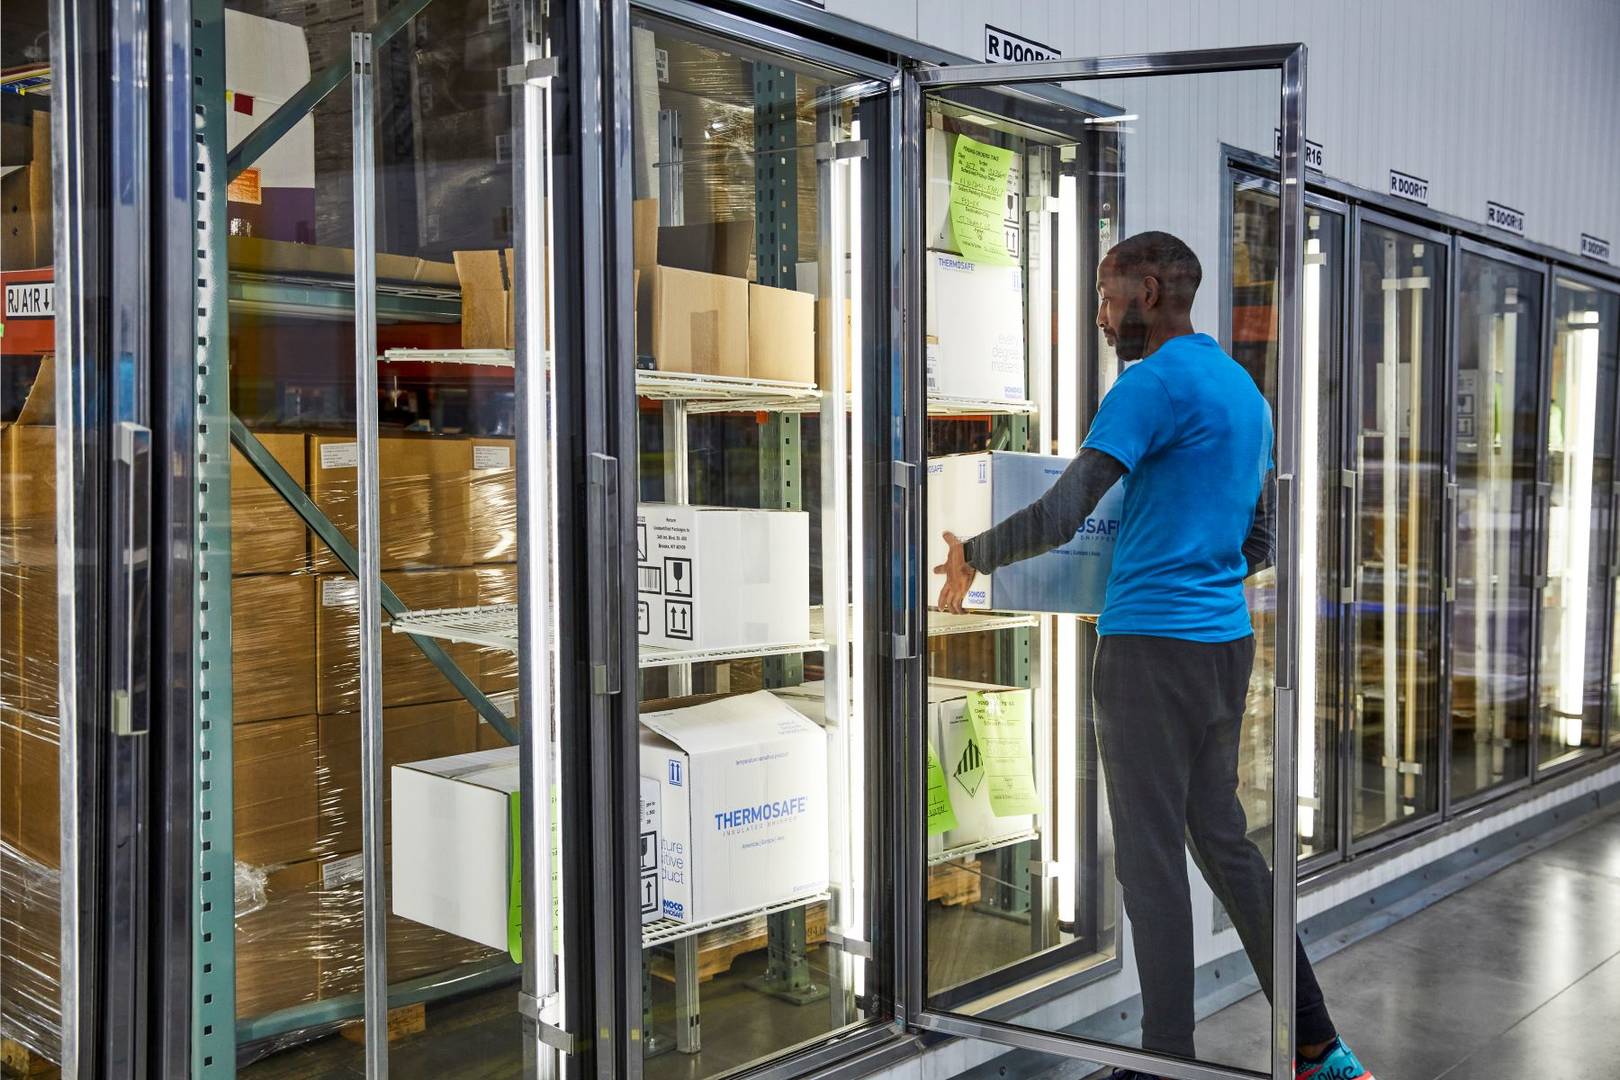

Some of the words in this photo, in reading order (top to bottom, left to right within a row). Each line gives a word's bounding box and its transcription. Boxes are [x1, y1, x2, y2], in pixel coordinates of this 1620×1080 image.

[988, 34, 1000, 57] R
[1391, 176, 1397, 190] R
[1399, 178, 1428, 200] DOOR17
